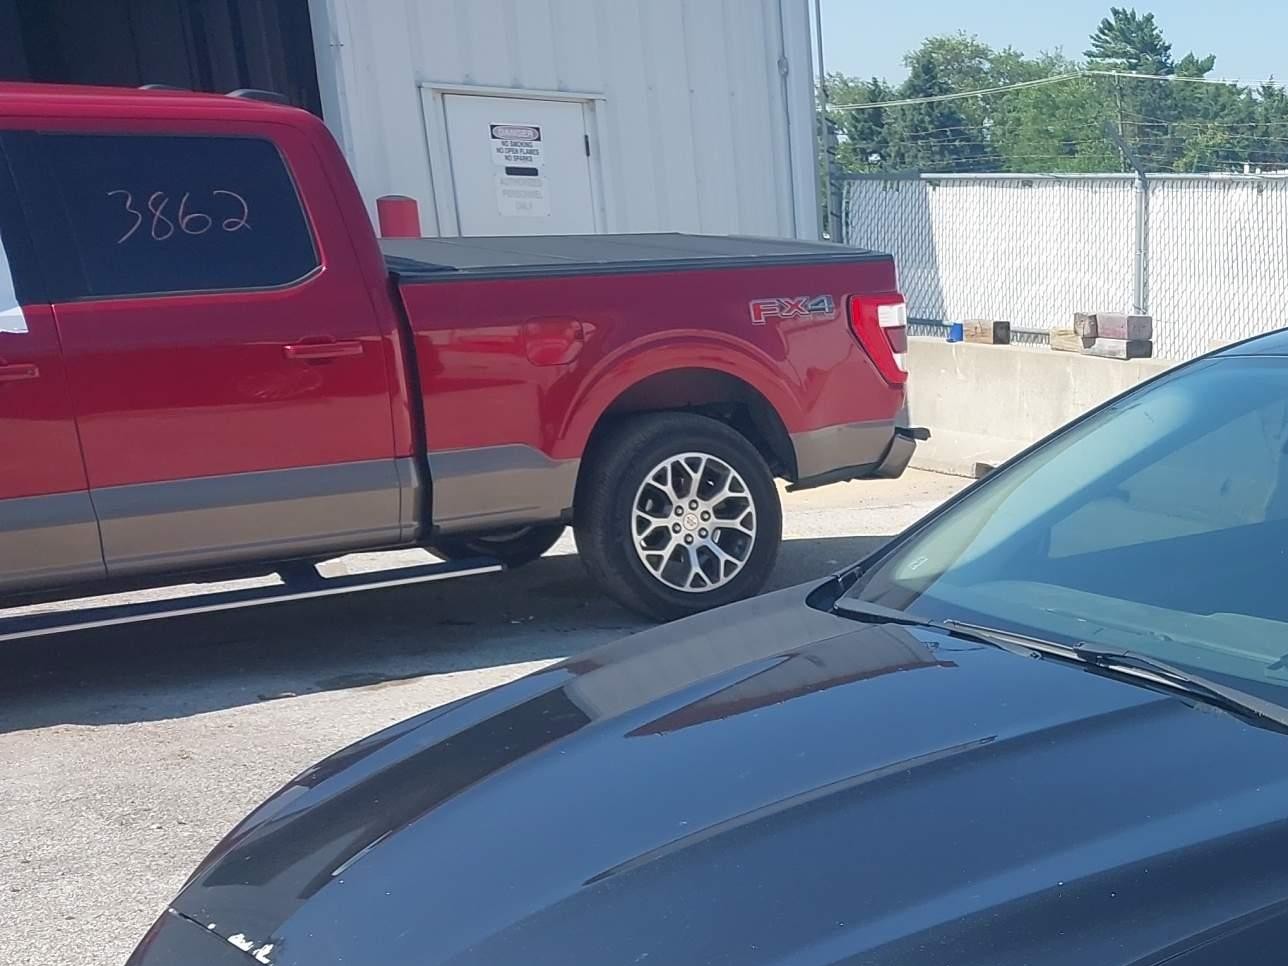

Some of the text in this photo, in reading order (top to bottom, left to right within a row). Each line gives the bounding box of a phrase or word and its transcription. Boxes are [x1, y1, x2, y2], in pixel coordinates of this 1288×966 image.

[498, 129, 534, 138] DANGER
[107, 189, 253, 244] 3862
[749, 294, 834, 325] FX4
